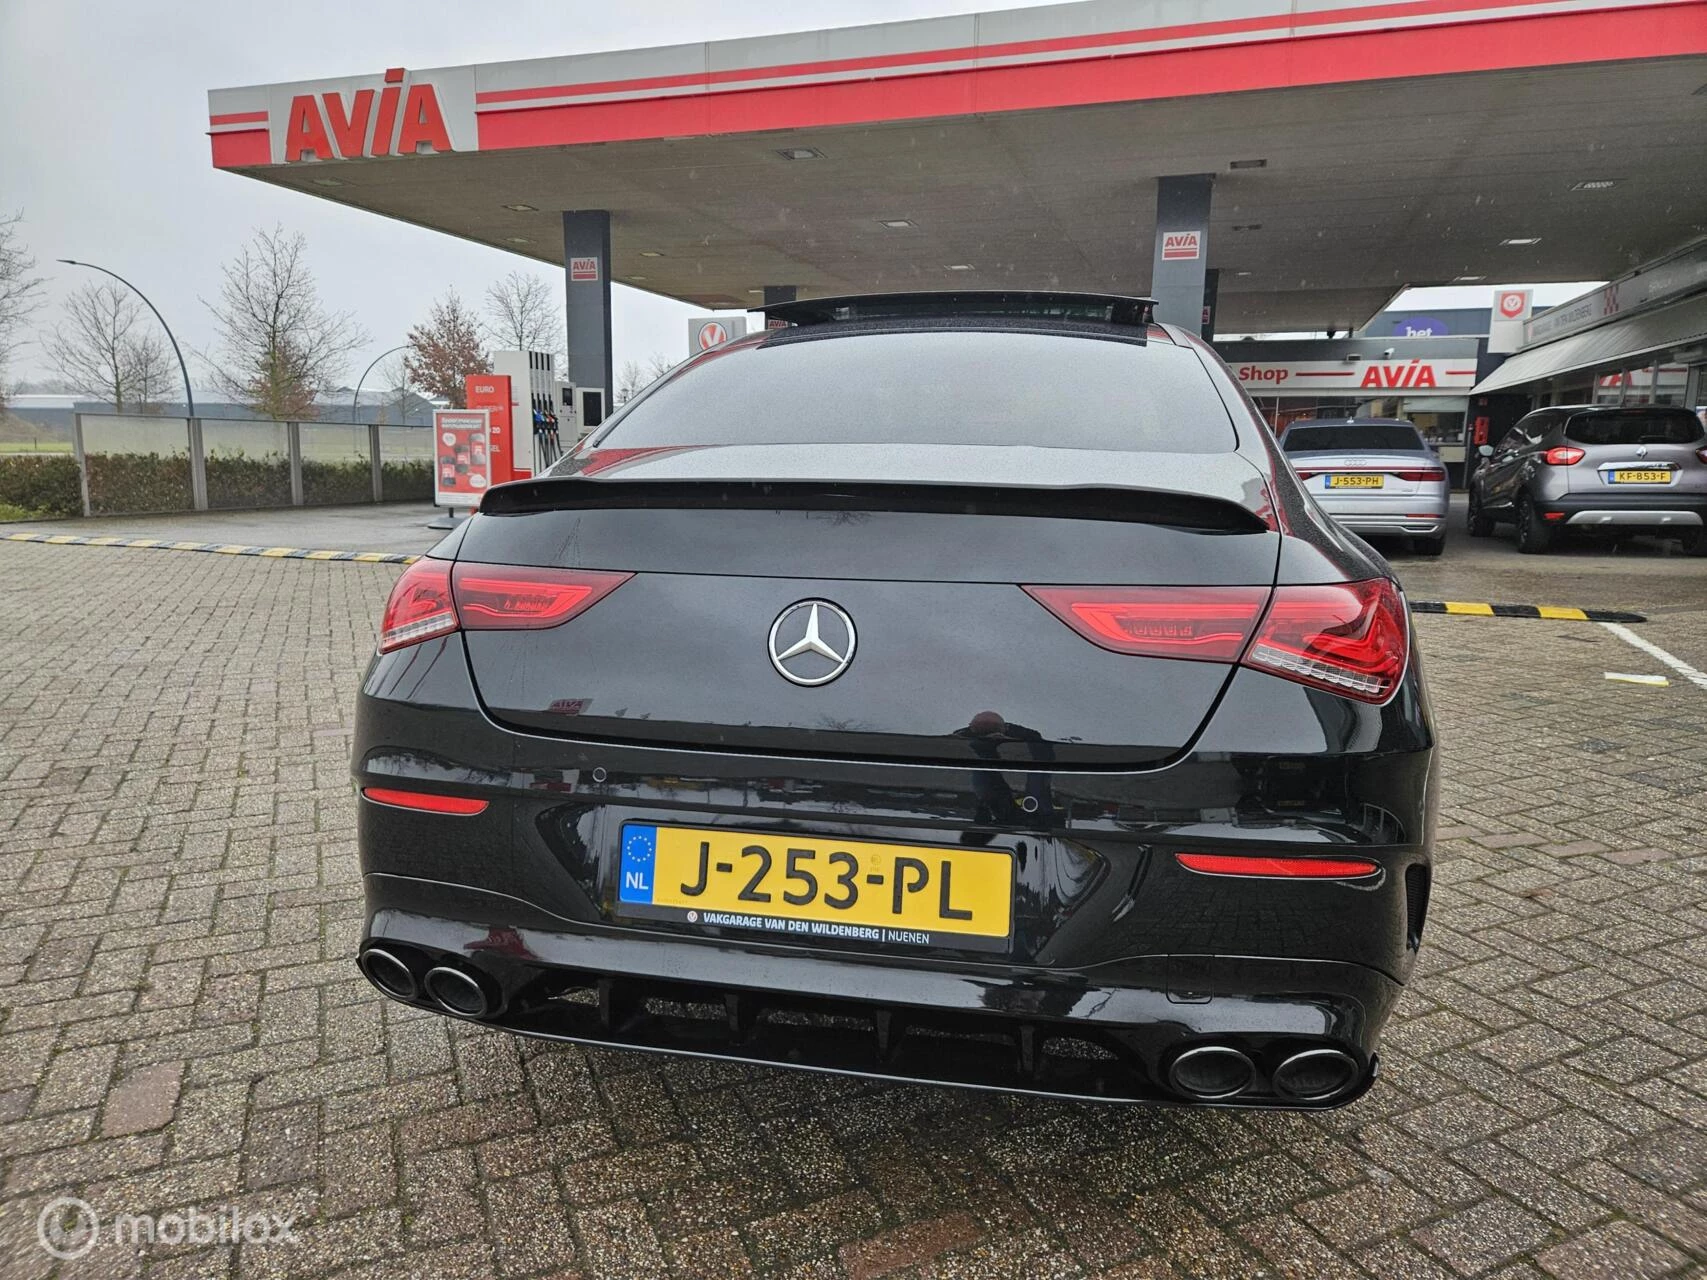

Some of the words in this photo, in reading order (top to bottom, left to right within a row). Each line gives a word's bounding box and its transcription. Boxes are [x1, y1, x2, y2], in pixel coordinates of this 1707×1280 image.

[285, 67, 453, 162] AVIA
[1165, 233, 1197, 247] AVIA
[573, 259, 596, 270] AVIA
[1238, 365, 1289, 385] Shop
[1360, 359, 1437, 389] AVIA
[475, 385, 495, 393] EURO
[1334, 475, 1379, 485] J-553-PH
[1619, 472, 1667, 481] KF-853-F
[625, 872, 649, 890] NL
[680, 841, 973, 921] J-253-PL
[703, 912, 763, 928] VAKGARAGE
[764, 918, 786, 930] VAN
[788, 920, 809, 932] DEN
[811, 922, 880, 939] WILDENBERG
[888, 930, 930, 944] NUENEN
